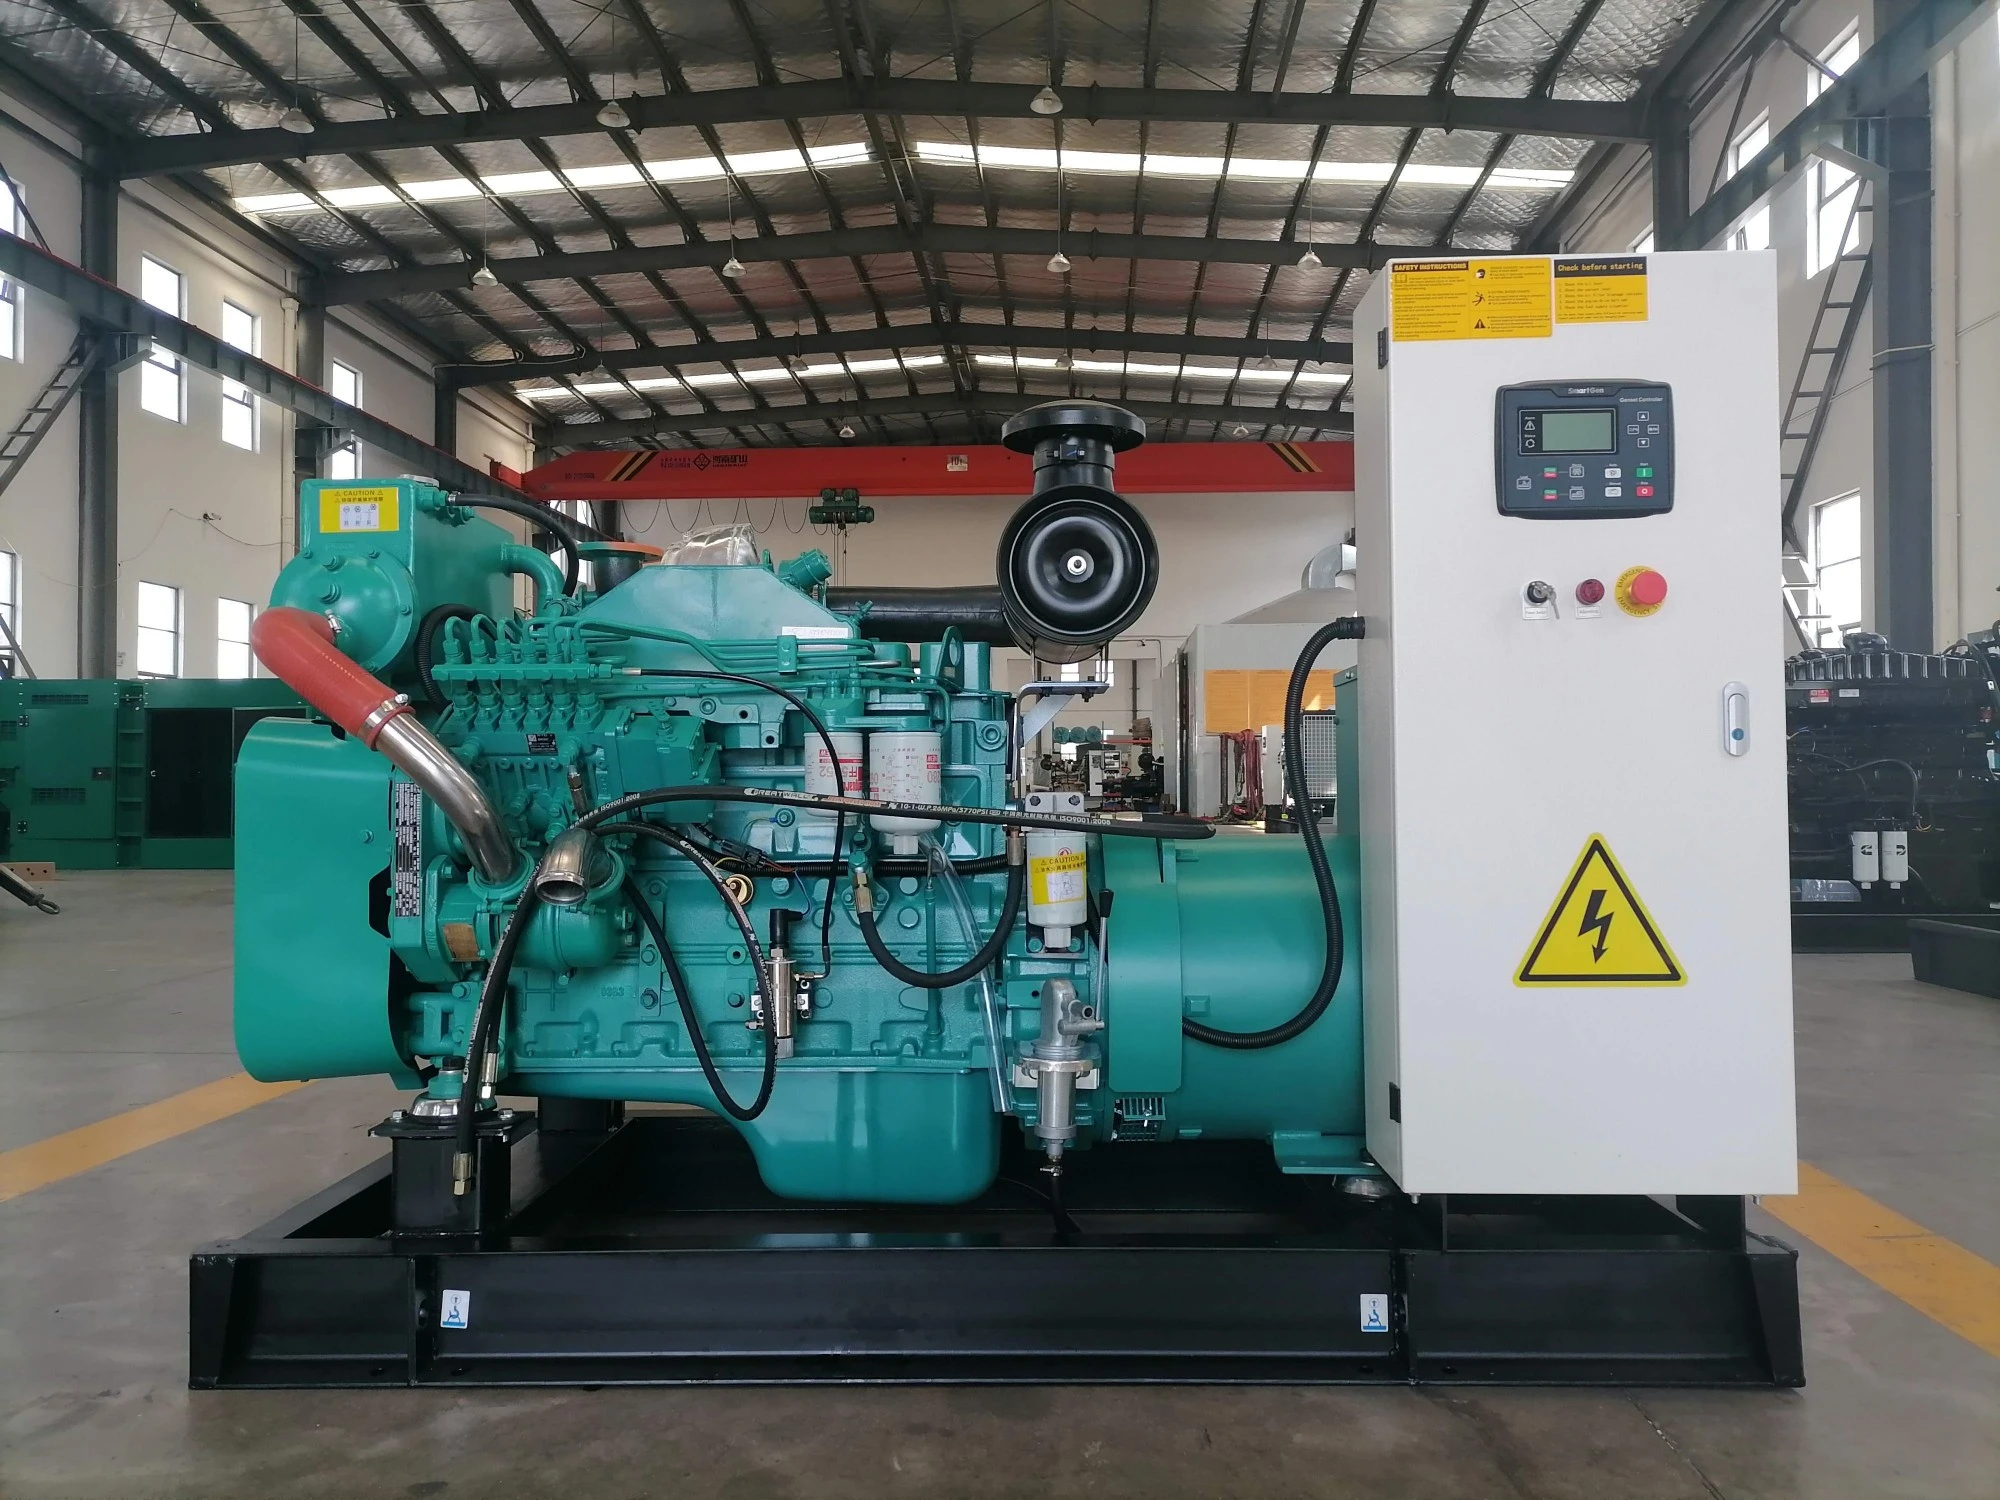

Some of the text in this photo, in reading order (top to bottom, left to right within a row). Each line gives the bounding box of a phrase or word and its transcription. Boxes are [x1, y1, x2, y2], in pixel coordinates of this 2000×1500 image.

[1557, 261, 1643, 272] Check before starting
[1617, 596, 1650, 615] EMERGENCY
[819, 766, 858, 778] FF552
[1049, 855, 1080, 865] CAUTION
